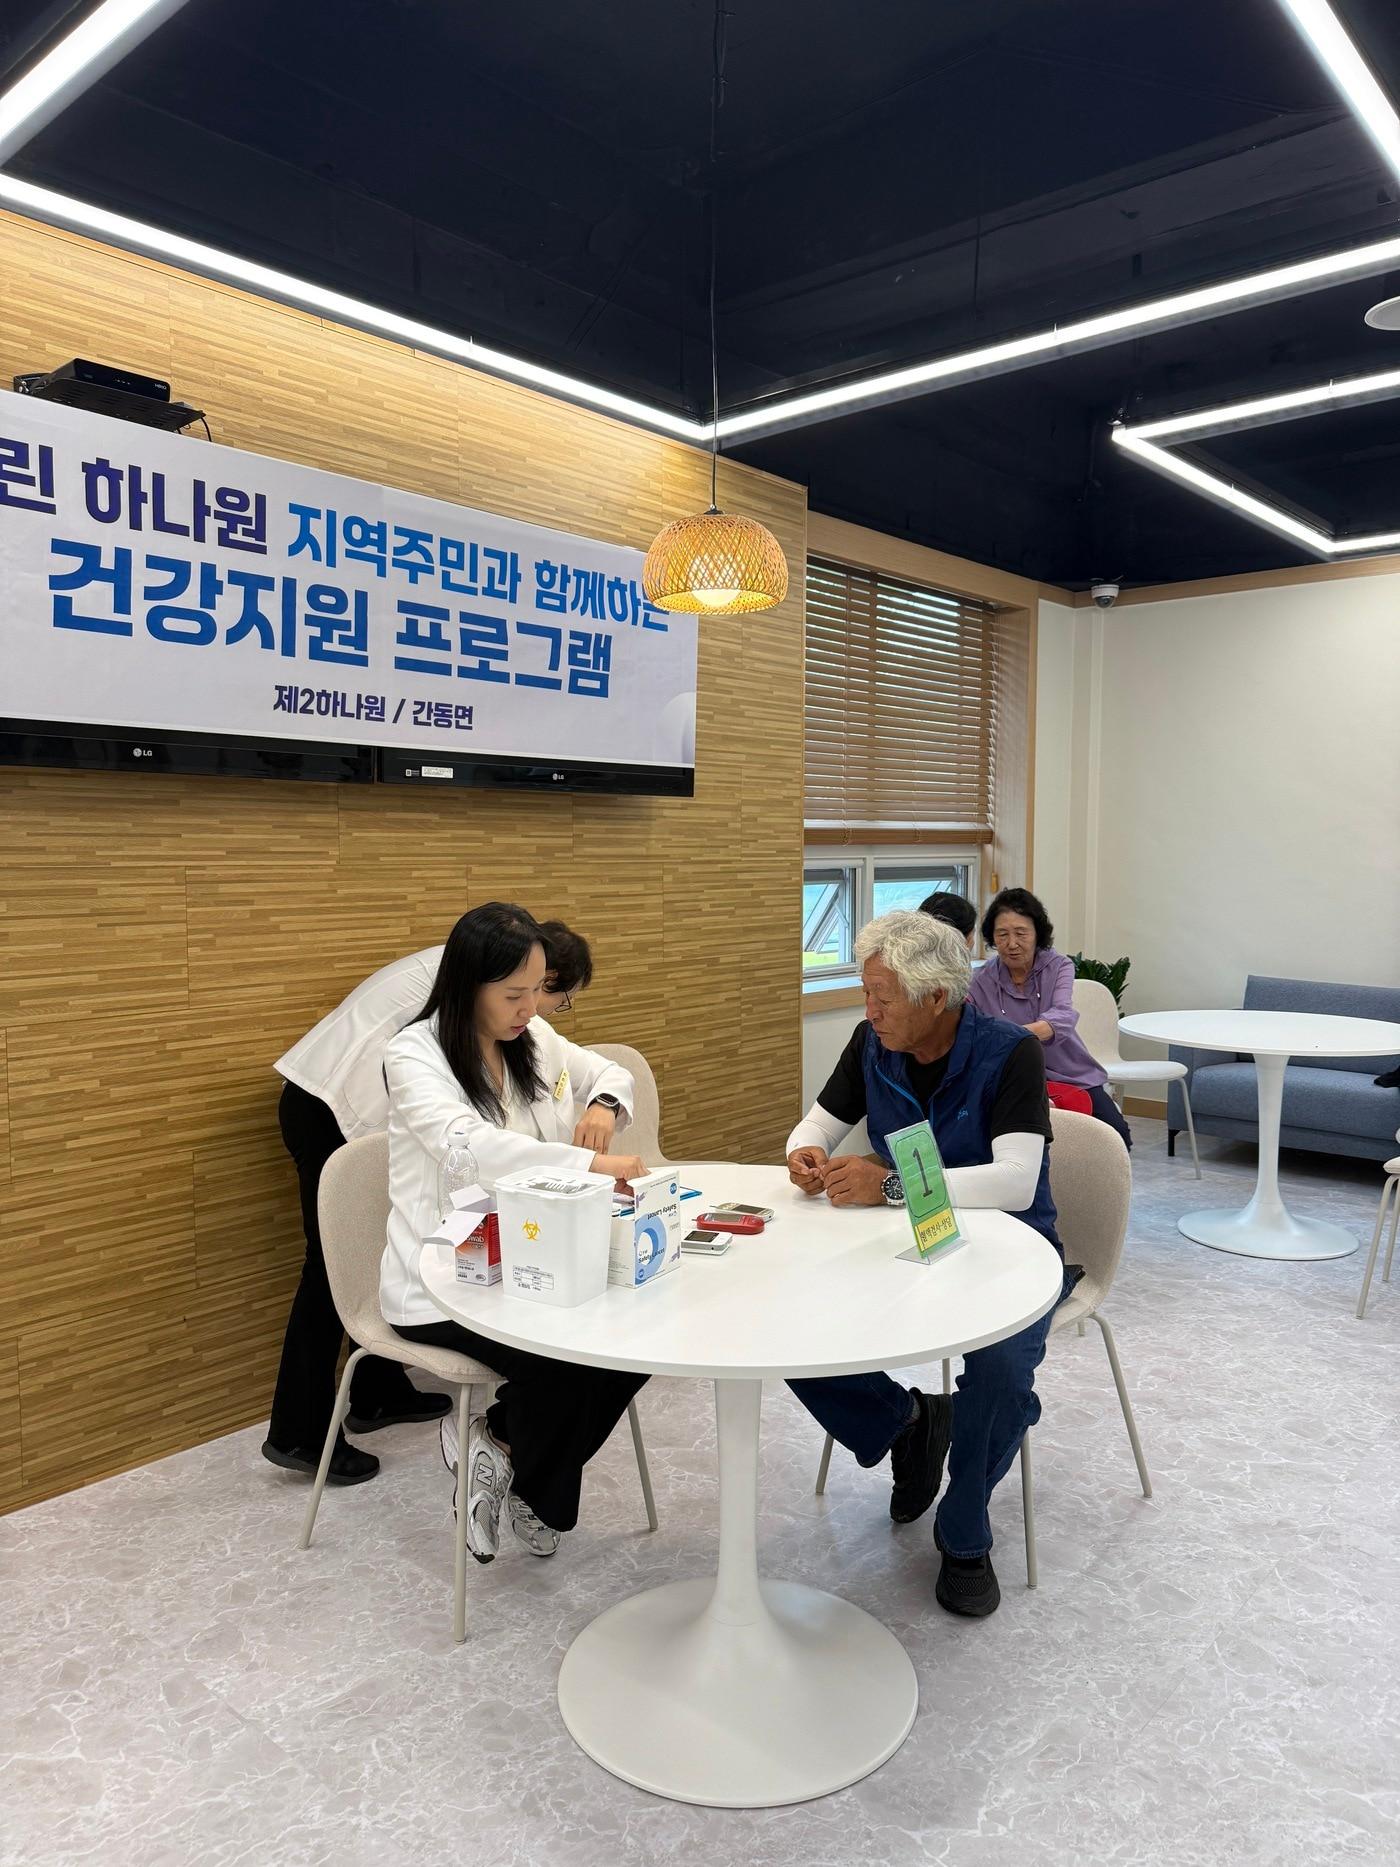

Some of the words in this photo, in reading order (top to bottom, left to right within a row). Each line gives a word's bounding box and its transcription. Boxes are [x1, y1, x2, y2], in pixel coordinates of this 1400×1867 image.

[81, 457, 268, 555] 하나원
[288, 502, 522, 604] 지역주민과
[48, 538, 369, 667] 건강지원
[394, 600, 613, 698] 프로그램
[273, 685, 386, 722] 제2하나원
[391, 698, 407, 724] /
[412, 700, 474, 730] 간동면
[912, 1147, 933, 1198] 1
